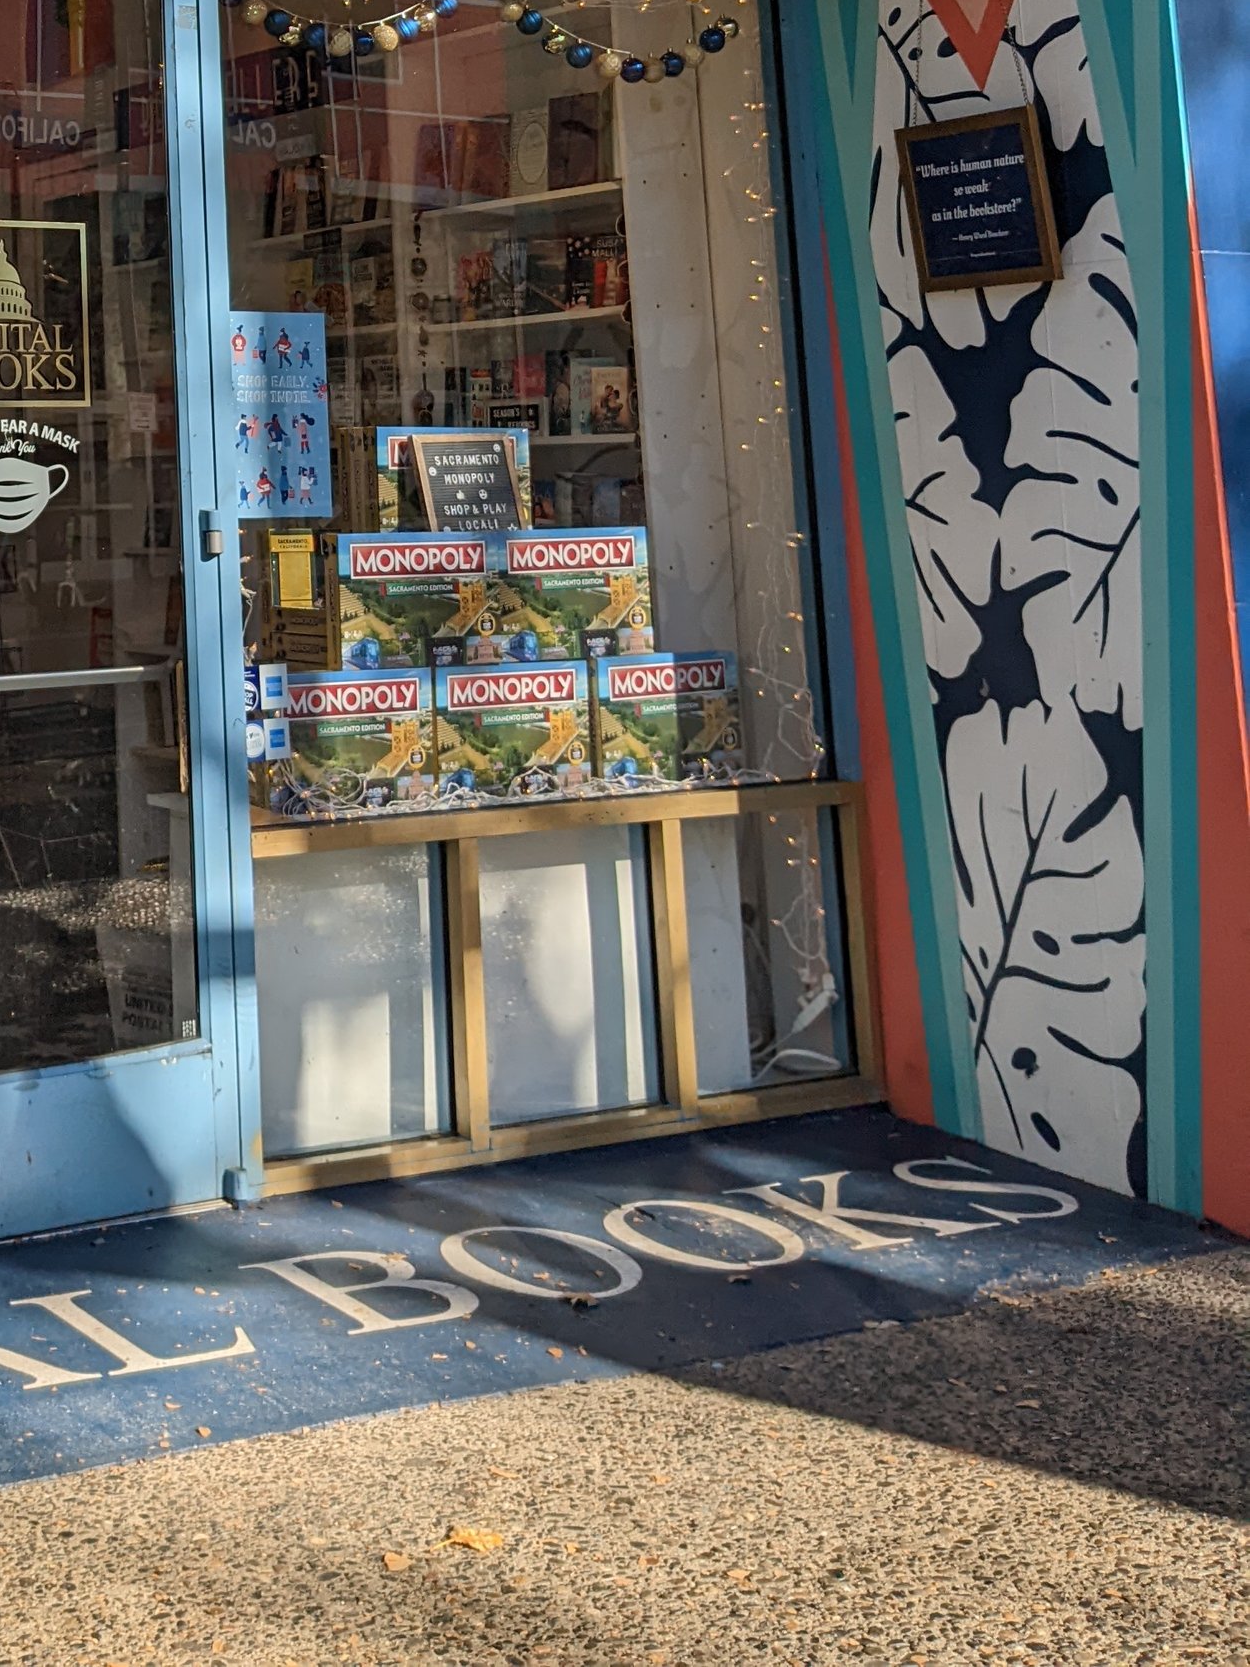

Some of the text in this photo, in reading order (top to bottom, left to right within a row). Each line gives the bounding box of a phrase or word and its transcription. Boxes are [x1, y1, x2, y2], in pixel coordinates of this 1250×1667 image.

[951, 154, 1024, 174] is human nature
[954, 179, 990, 197] so weak
[932, 206, 968, 222] as in the
[12, 438, 37, 456] You
[29, 422, 40, 436] A
[40, 425, 81, 455] MASK
[434, 454, 500, 466] SACRAMENTO
[444, 472, 495, 485] MONOPOLY
[444, 503, 507, 516] SHOP & PLAY
[355, 546, 482, 574] MONOPOLY
[511, 541, 631, 569] MONOPOLY
[388, 584, 454, 594] SACRAMENTO EDITION
[544, 577, 605, 587] SACRAMENTO EDITION
[613, 664, 722, 695] MONOPOLY
[452, 674, 572, 704] MONOPOLY
[287, 683, 415, 715] MONOPOLY
[483, 712, 545, 723] SACRAMENTO EDITION
[319, 723, 386, 734] SACRAMENTO EDITION
[241, 1157, 1081, 1335] BOOKS
